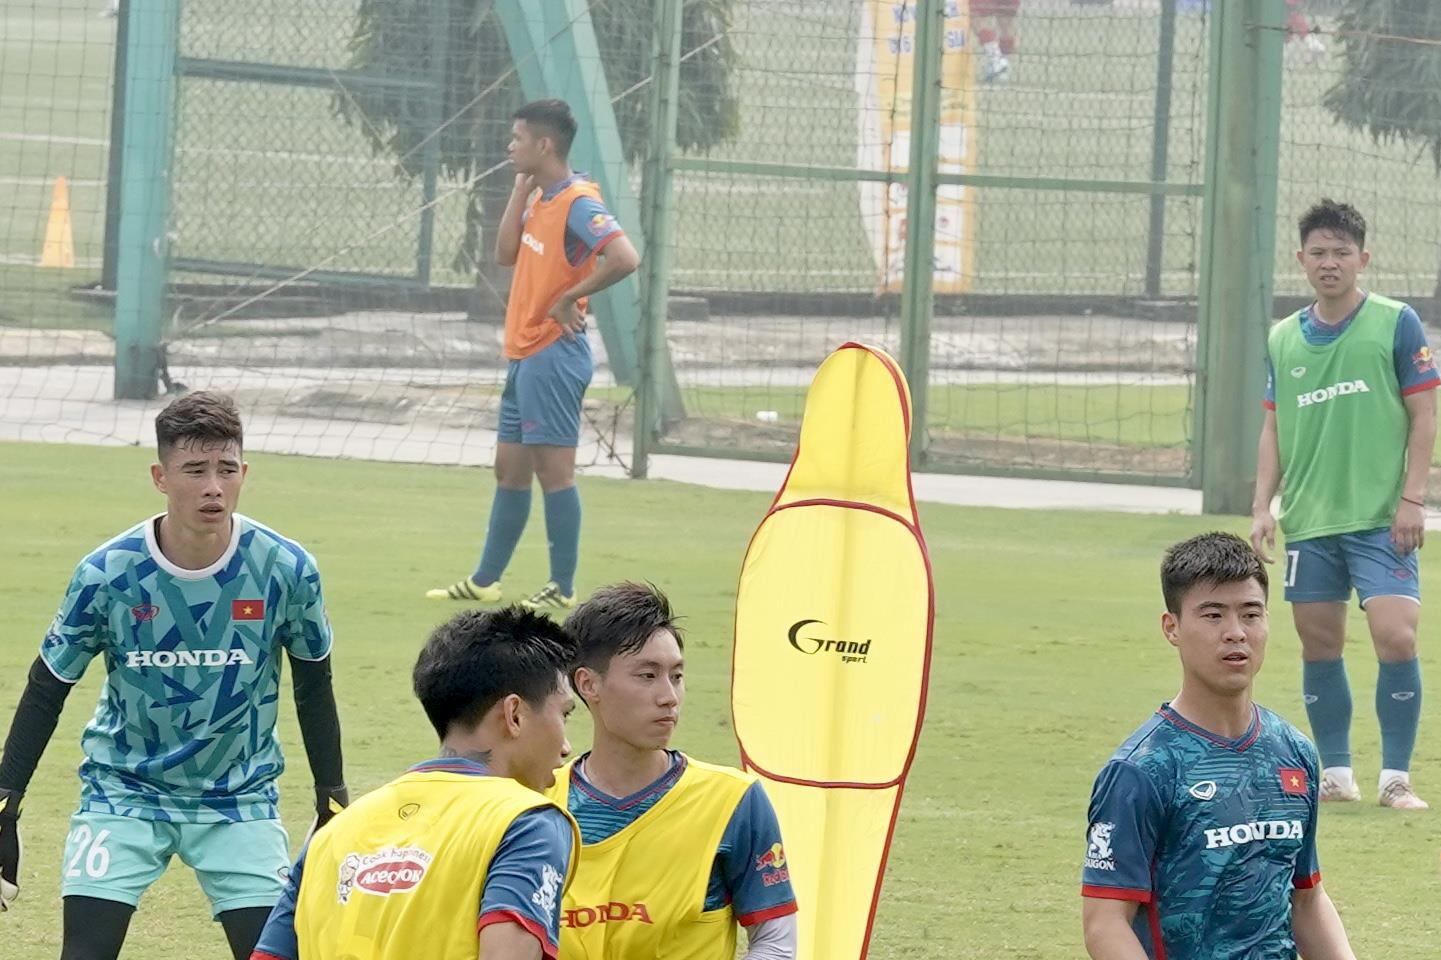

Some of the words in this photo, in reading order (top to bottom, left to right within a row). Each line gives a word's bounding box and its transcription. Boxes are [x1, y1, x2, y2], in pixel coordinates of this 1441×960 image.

[1297, 379, 1370, 408] HONDA
[1284, 550, 1300, 587] 7
[788, 619, 872, 655] Grand
[126, 648, 254, 668] HONDA
[65, 823, 112, 878] 26
[1204, 820, 1304, 849] HONDA
